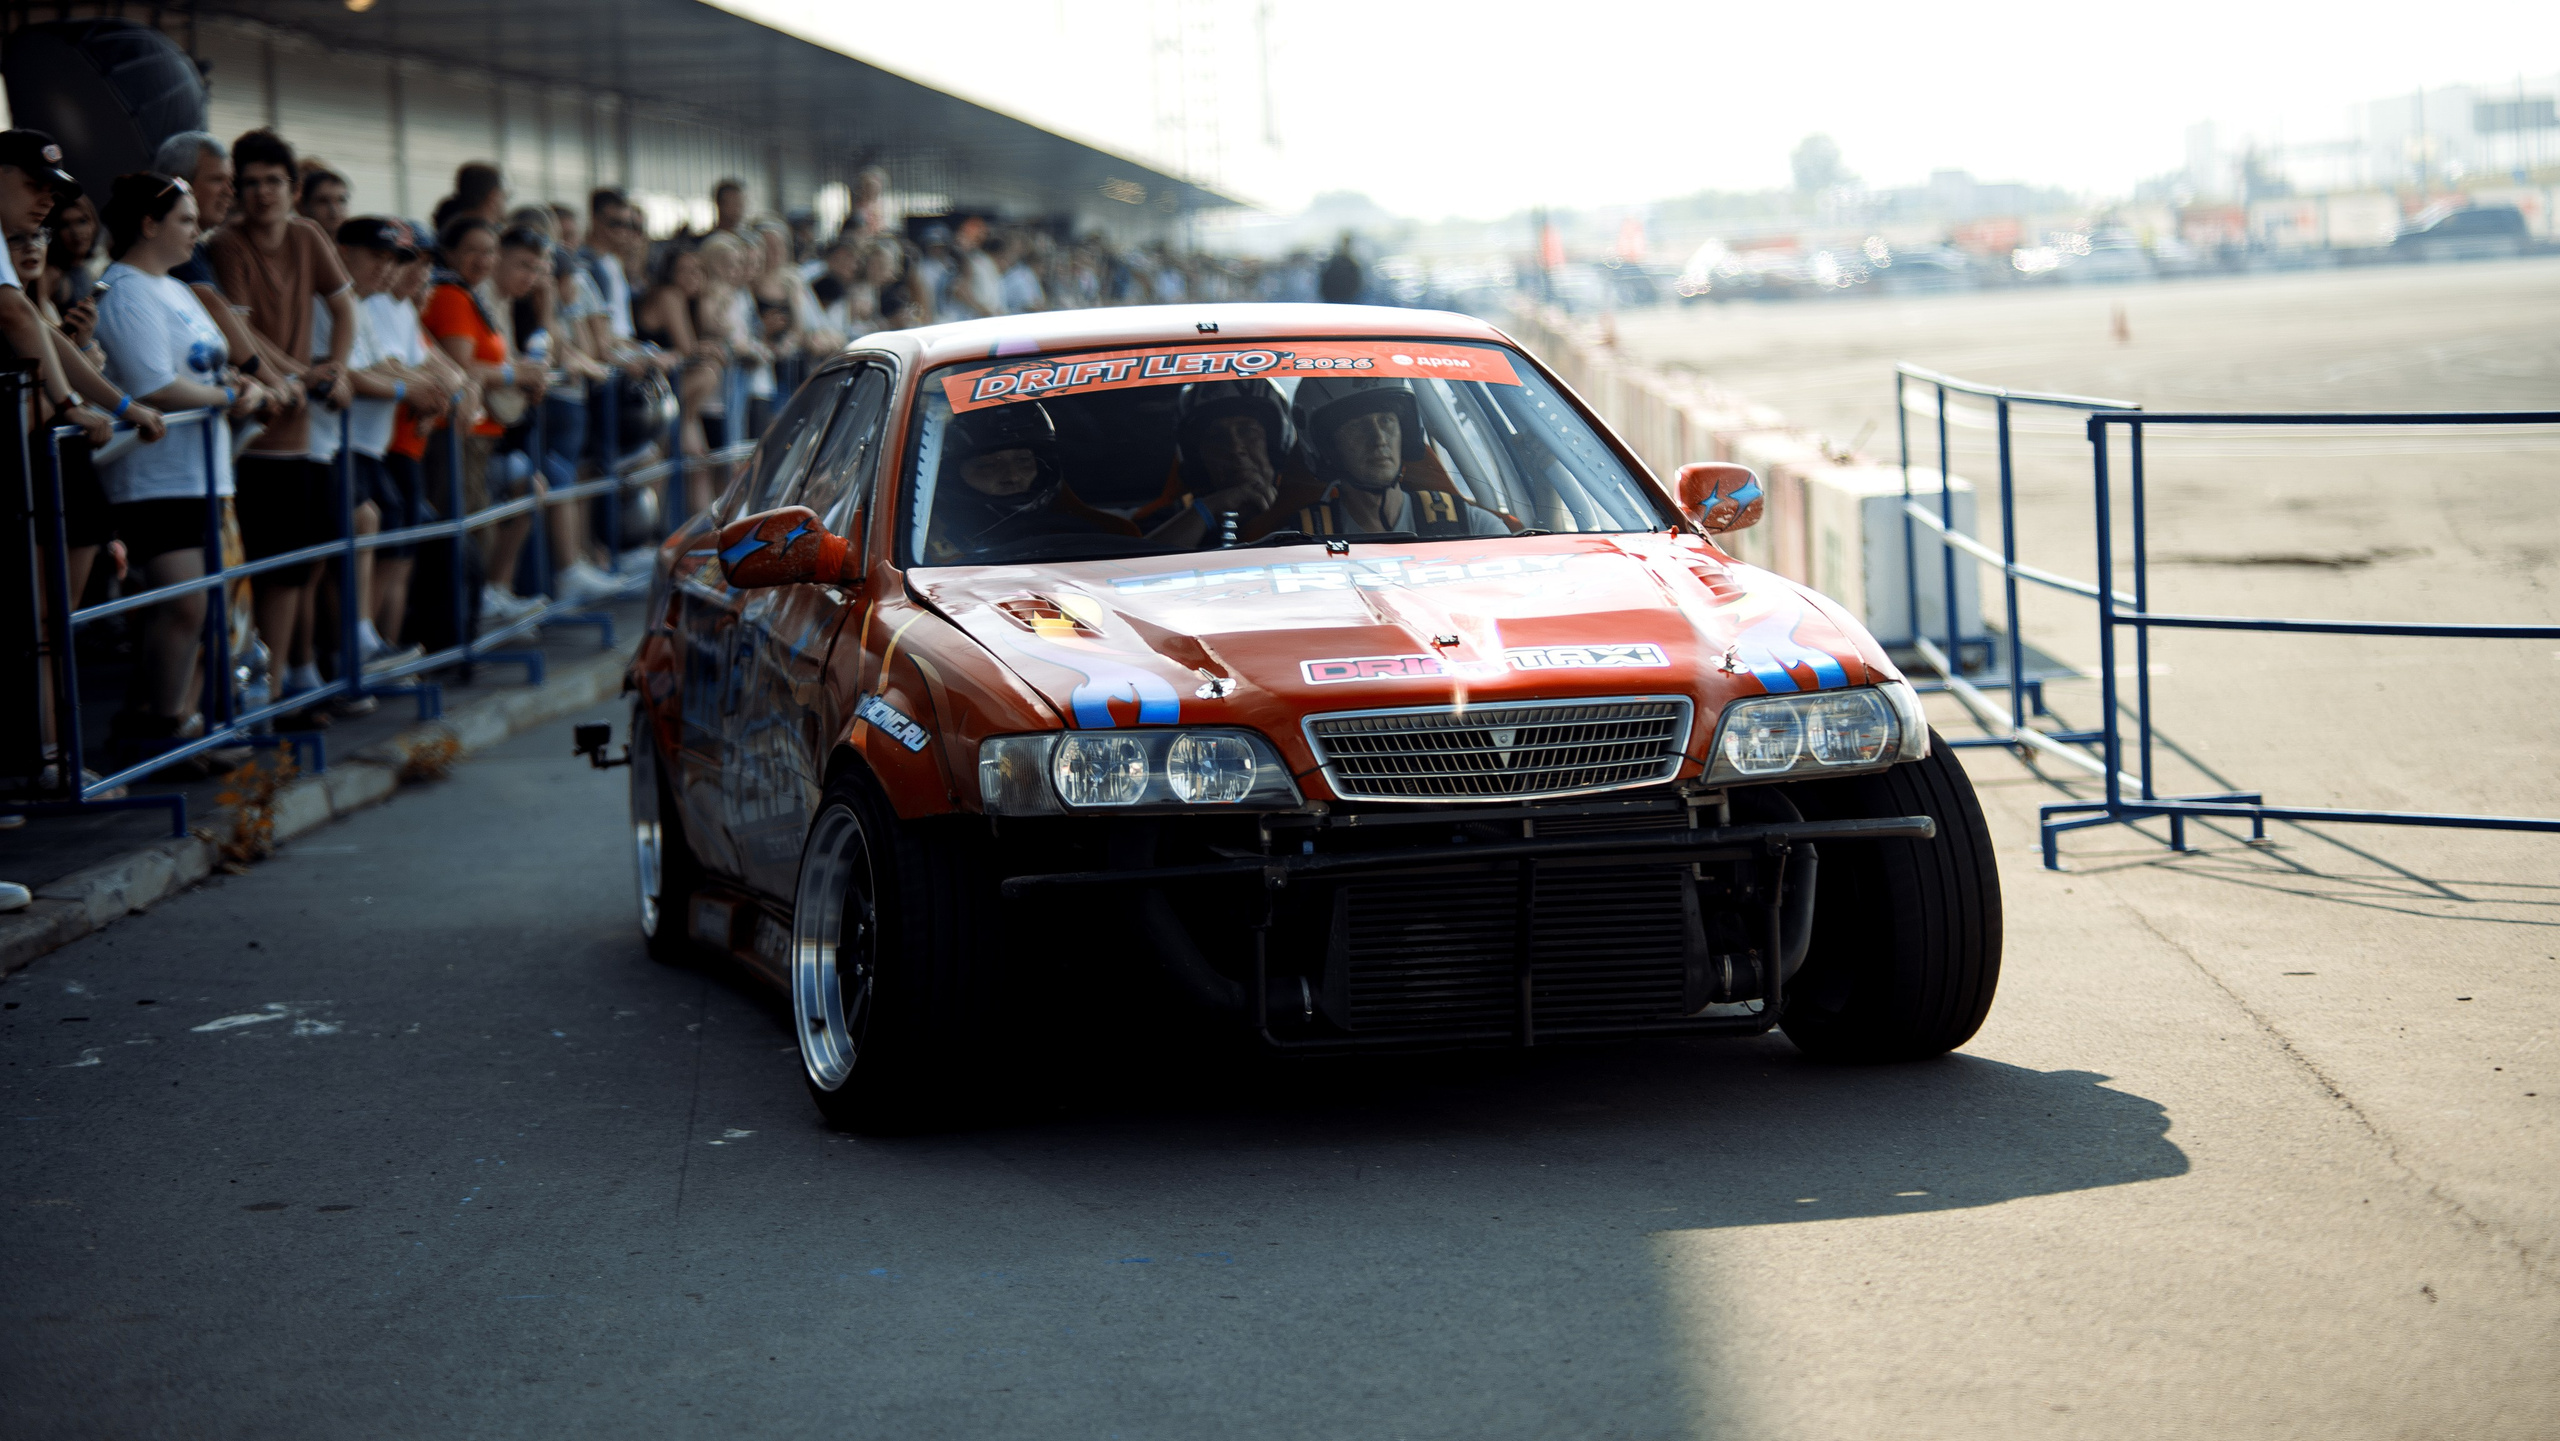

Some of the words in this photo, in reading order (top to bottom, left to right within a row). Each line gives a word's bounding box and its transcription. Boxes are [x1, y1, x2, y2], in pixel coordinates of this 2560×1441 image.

[973, 358, 1141, 401] DRIFT
[1143, 350, 1280, 378] LETO
[1294, 357, 1375, 369] 2026
[1417, 356, 1470, 368] дром
